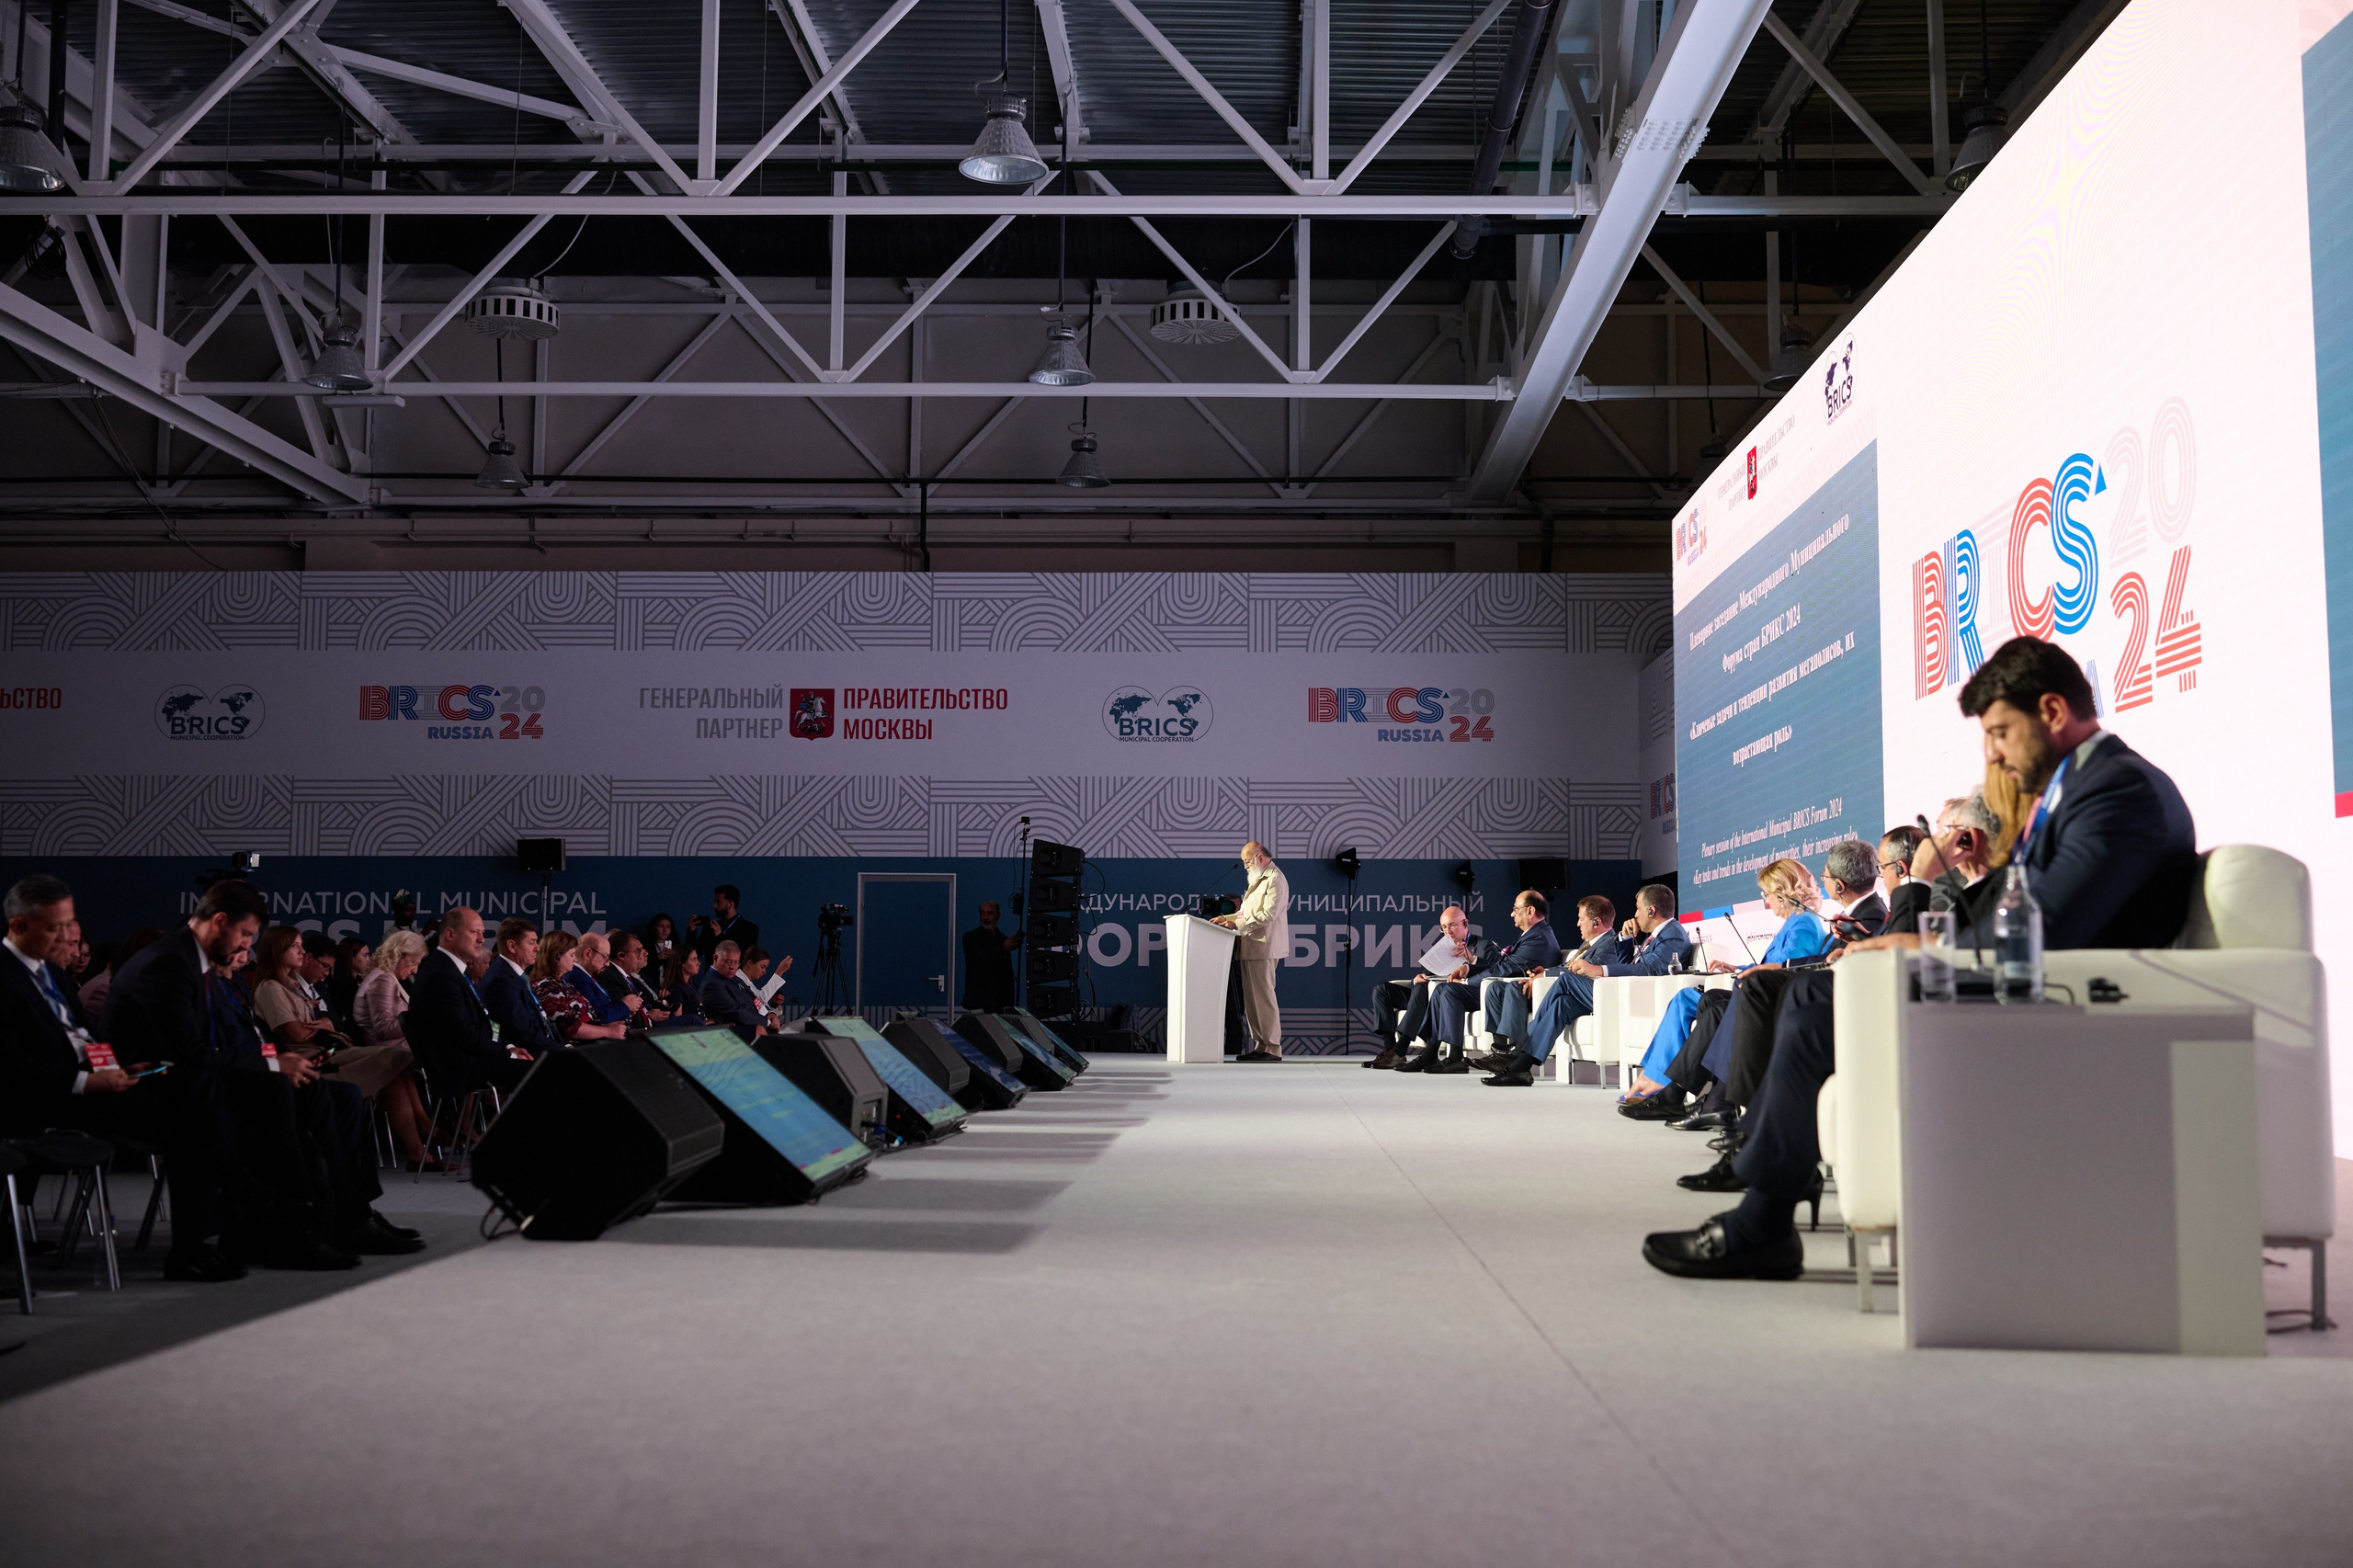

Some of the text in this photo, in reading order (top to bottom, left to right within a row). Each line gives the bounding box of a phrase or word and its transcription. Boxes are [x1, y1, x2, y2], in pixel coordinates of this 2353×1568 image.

[1827, 375, 1853, 418] BRICS
[1677, 508, 1699, 562] BRICS
[1912, 395, 2198, 701] BRICS 20
[1689, 514, 1849, 652] Пленарное заседание Международного Муниципального
[1722, 602, 1802, 675] Форума стран БРИКС 2024
[2109, 543, 2203, 714] 24
[0, 687, 62, 709] ЬСТВО
[639, 684, 1008, 710] ГЕНЕРАЛЬНЫЙ ПРАВИТЕЛЬСТВО
[1716, 704, 1733, 726] задачи
[1738, 683, 1768, 713] тенденции
[1768, 665, 1798, 702] развития
[1799, 640, 1844, 679] мегаполисов,
[1845, 631, 1855, 652] их
[358, 684, 546, 721] BRICS 20
[1308, 687, 1495, 723] BRICS 20
[170, 716, 245, 734] BRICS
[427, 713, 544, 740] RUSSIA 24
[696, 719, 933, 740] ПАРТНЕР МОСКВЫ
[1119, 718, 1194, 735] BRICS
[1378, 716, 1494, 742] RUSSIA 24
[1733, 724, 1793, 768] возрастающая роль»
[1701, 842, 1715, 859] Plenary
[1715, 837, 1730, 854] session
[1741, 822, 1768, 846] International
[1769, 813, 1792, 838] Municipal
[1793, 807, 1810, 830] BRICS
[1811, 806, 1828, 825] Forum
[1829, 797, 1843, 819] 2024
[1702, 867, 1711, 882] tasks
[1719, 860, 1731, 878] trends
[1743, 854, 1769, 873] development
[1802, 838, 1814, 857] their
[1287, 891, 1484, 915] УНИЦИПАЛЬНЫЙ
[1284, 924, 1483, 968] БРИК
